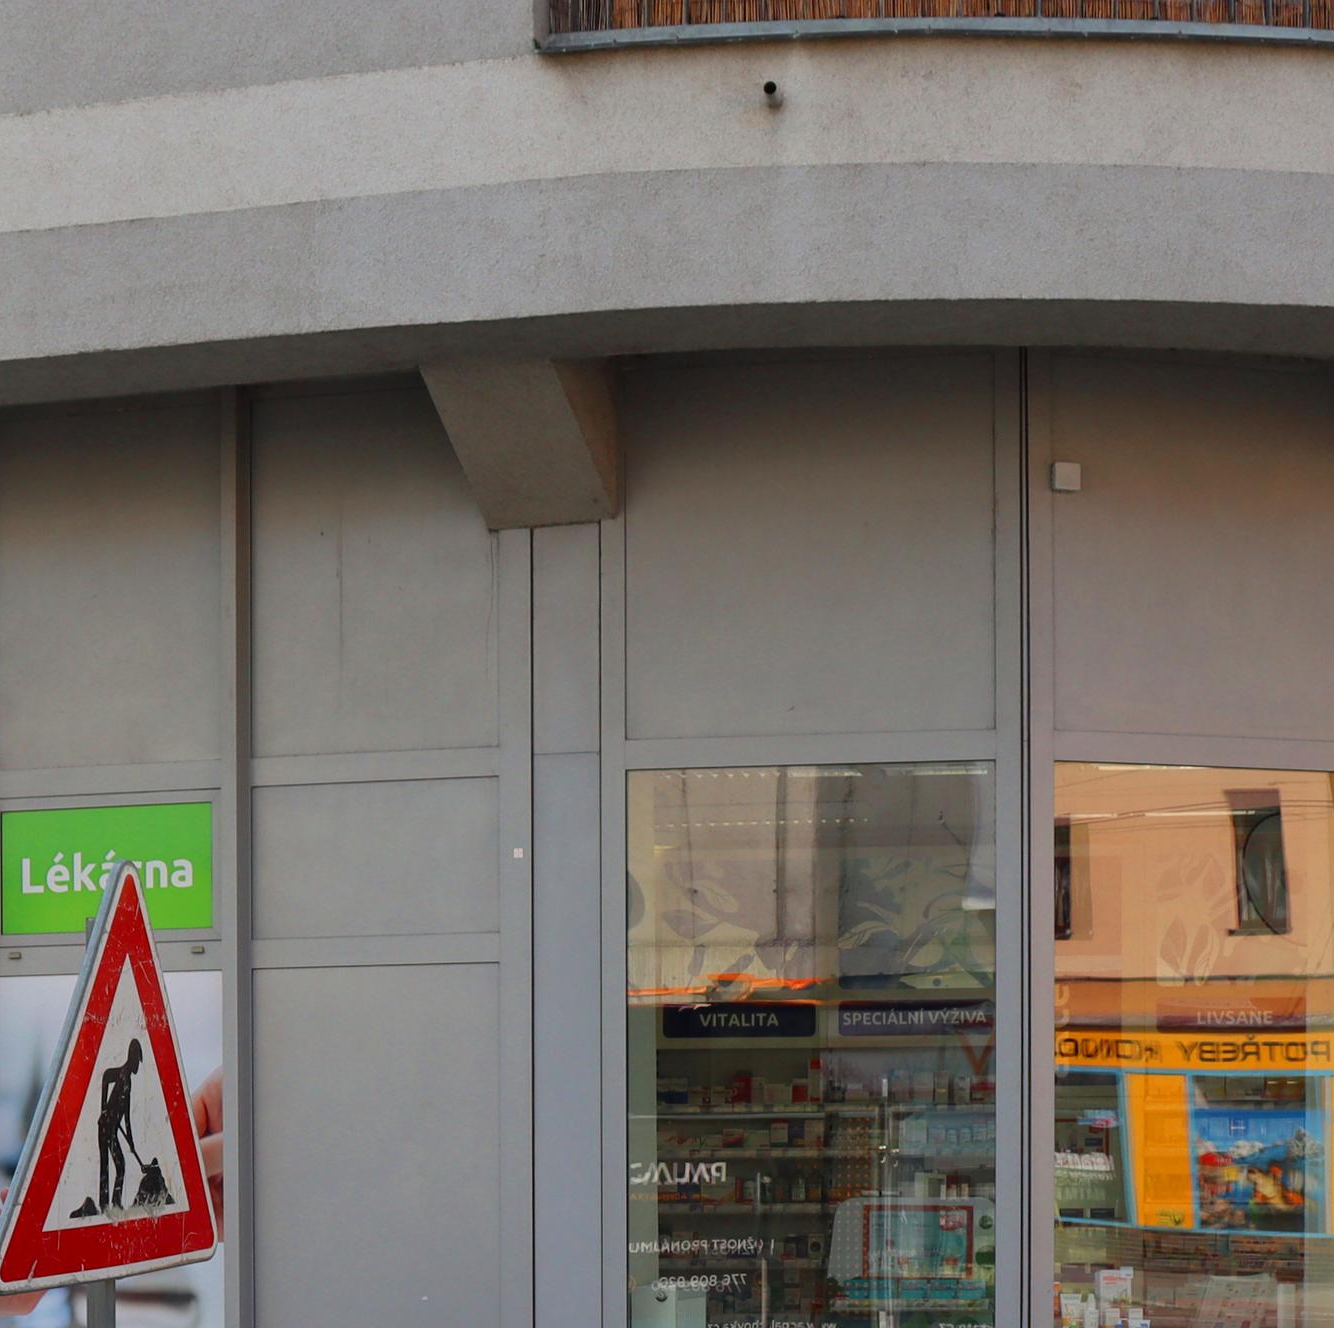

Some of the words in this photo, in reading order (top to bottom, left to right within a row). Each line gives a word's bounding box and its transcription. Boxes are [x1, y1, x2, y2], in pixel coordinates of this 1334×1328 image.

[699, 1012, 779, 1027] VITALITA
[842, 1009, 924, 1026] SPECIÁLNÍ
[928, 1006, 987, 1024] VÝŽIVA
[1197, 1010, 1273, 1025] LIVSANE
